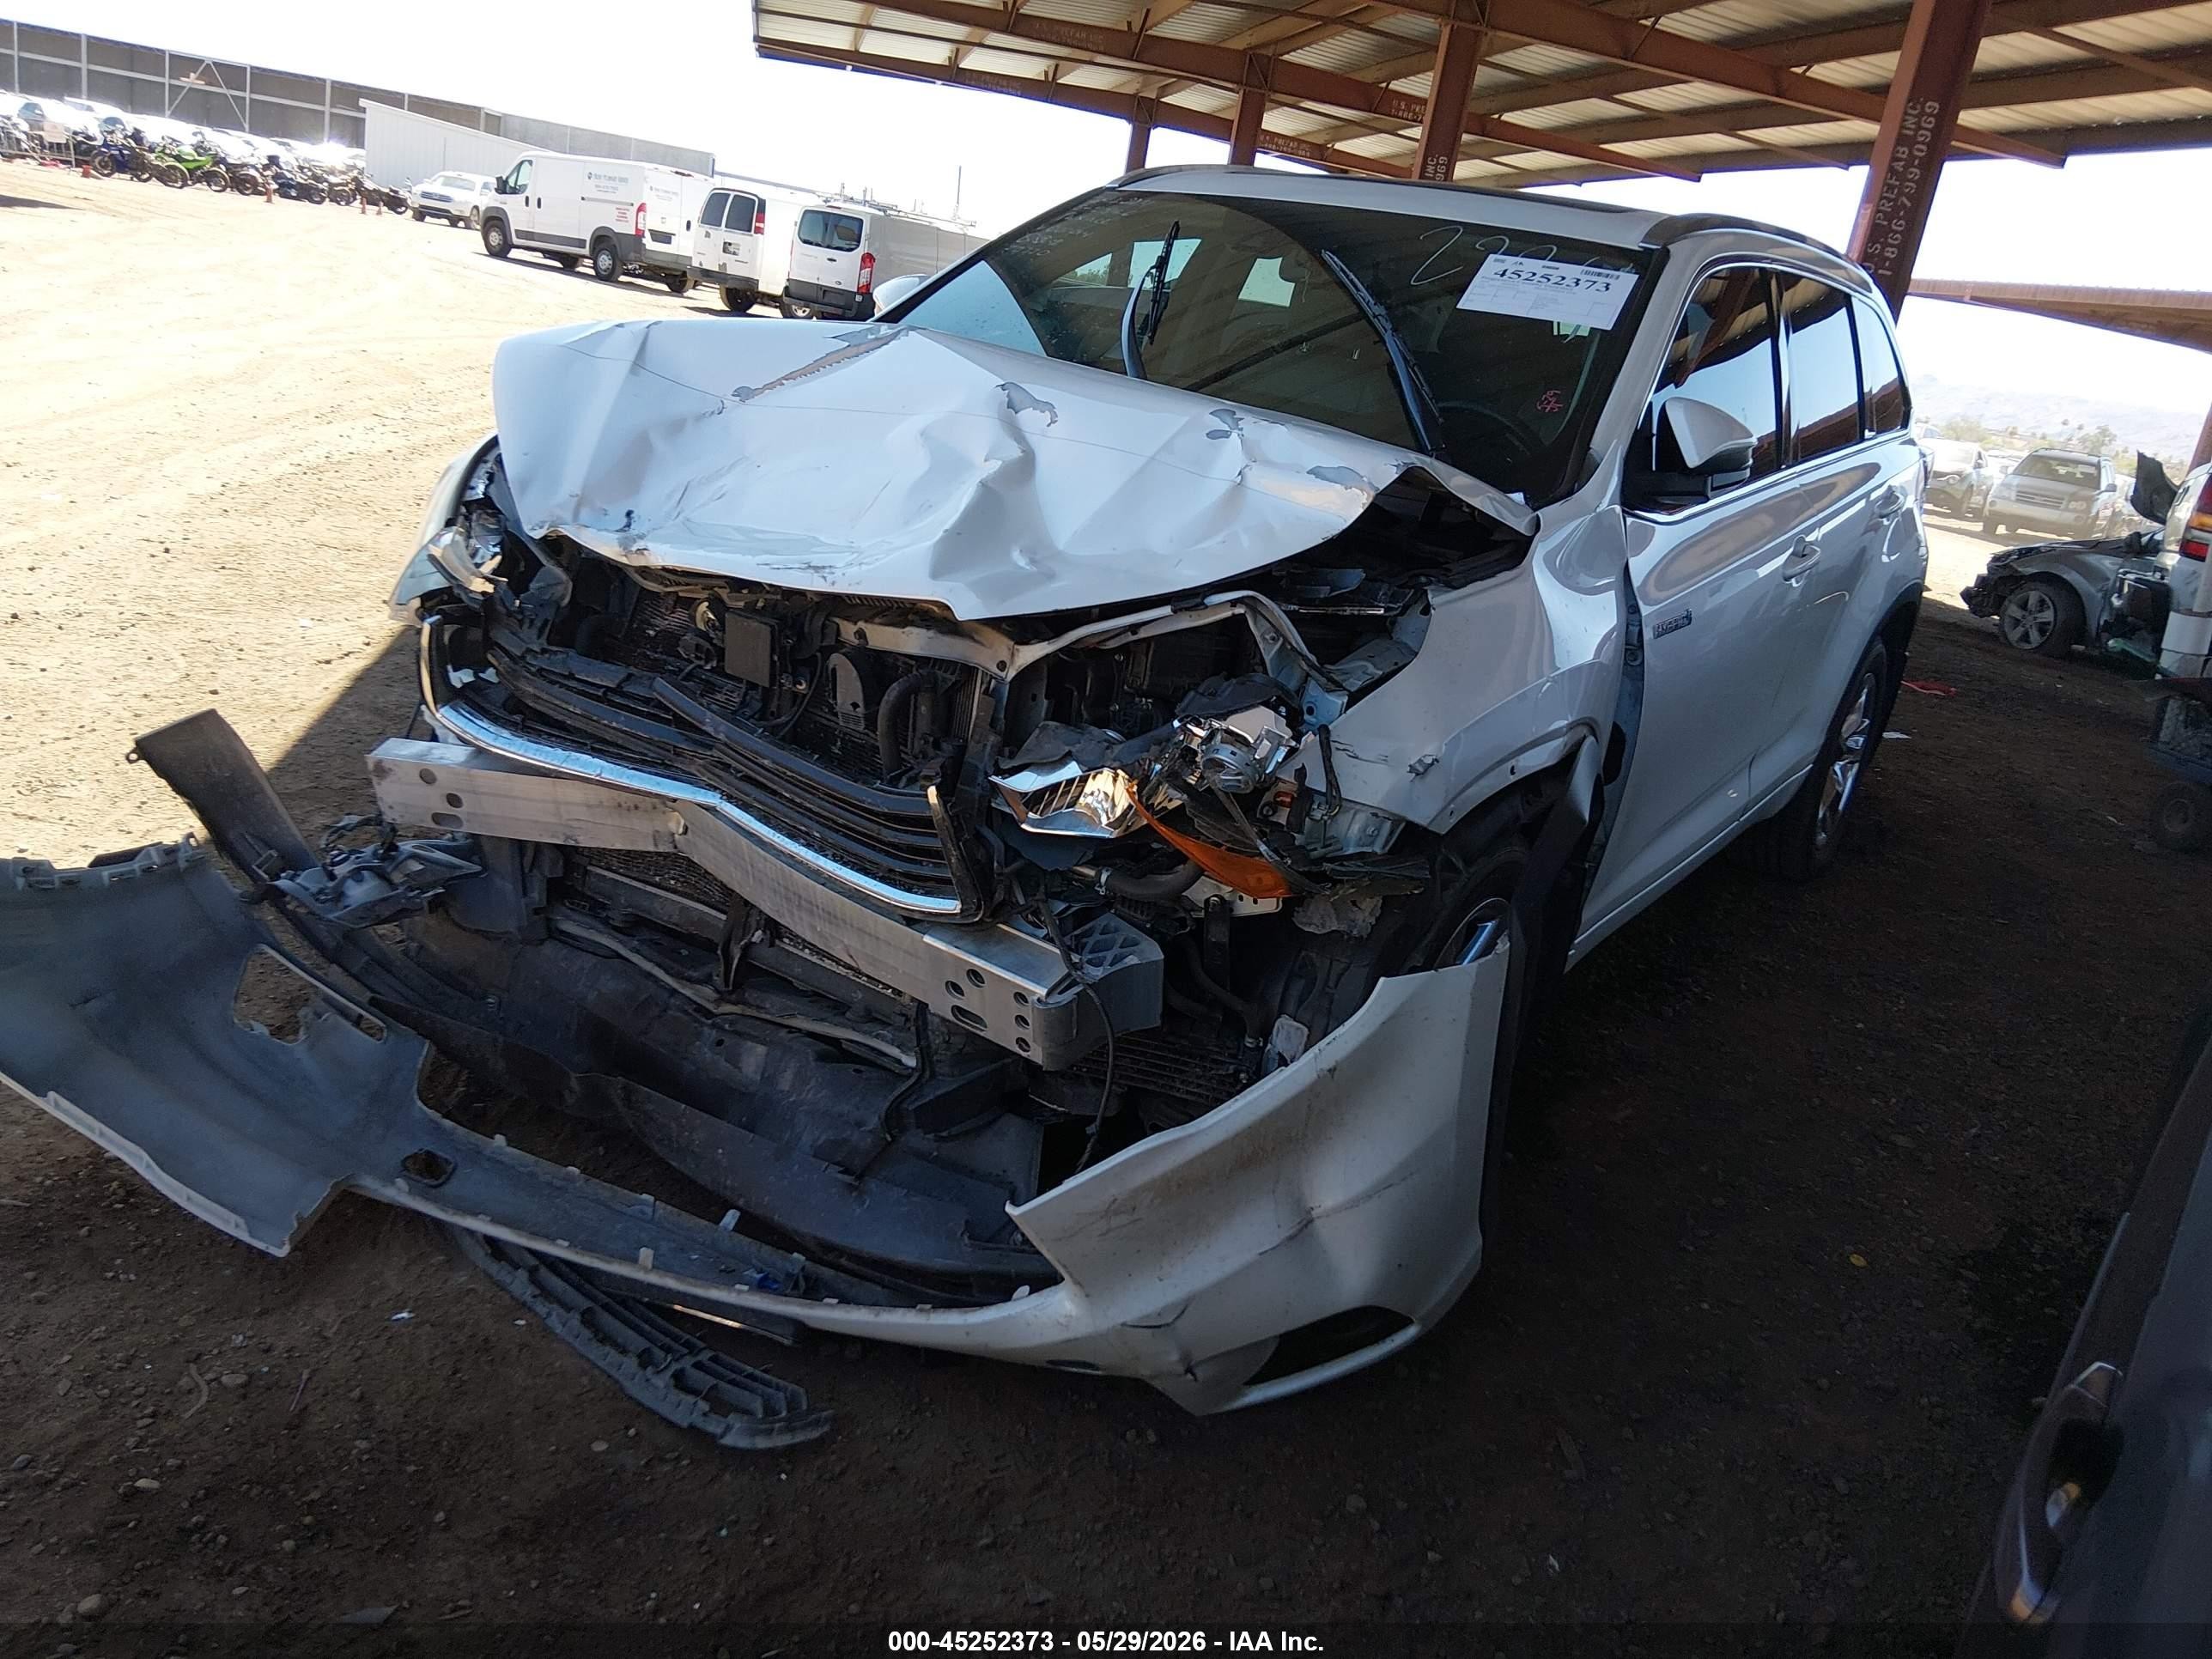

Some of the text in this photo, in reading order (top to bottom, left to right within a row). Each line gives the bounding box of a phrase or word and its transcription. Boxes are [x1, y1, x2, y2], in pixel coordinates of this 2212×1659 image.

[1424, 154, 1438, 178] INC.
[1875, 145, 1910, 226] PREFAB
[1901, 97, 1924, 136] INC.
[1877, 100, 1940, 276] 1-866-799-0969
[1493, 268, 1612, 293] 45252373
